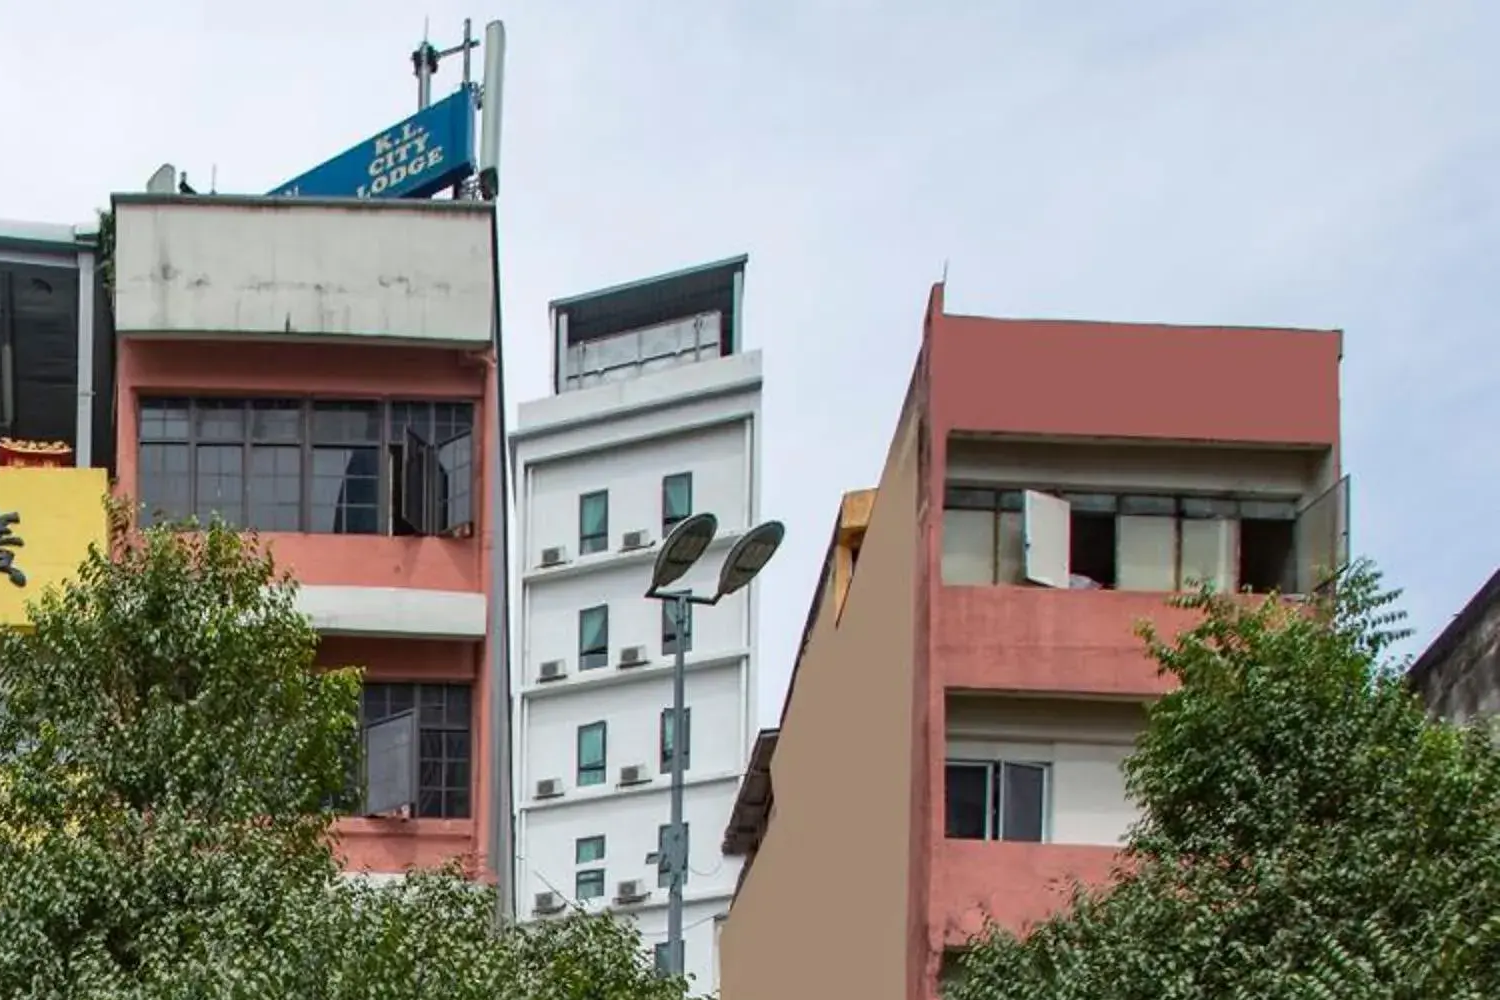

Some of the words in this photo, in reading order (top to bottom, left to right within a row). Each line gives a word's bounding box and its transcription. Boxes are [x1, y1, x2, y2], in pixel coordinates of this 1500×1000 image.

[368, 133, 429, 176] CITY
[375, 123, 423, 154] K.L.
[357, 147, 443, 199] LODGE
